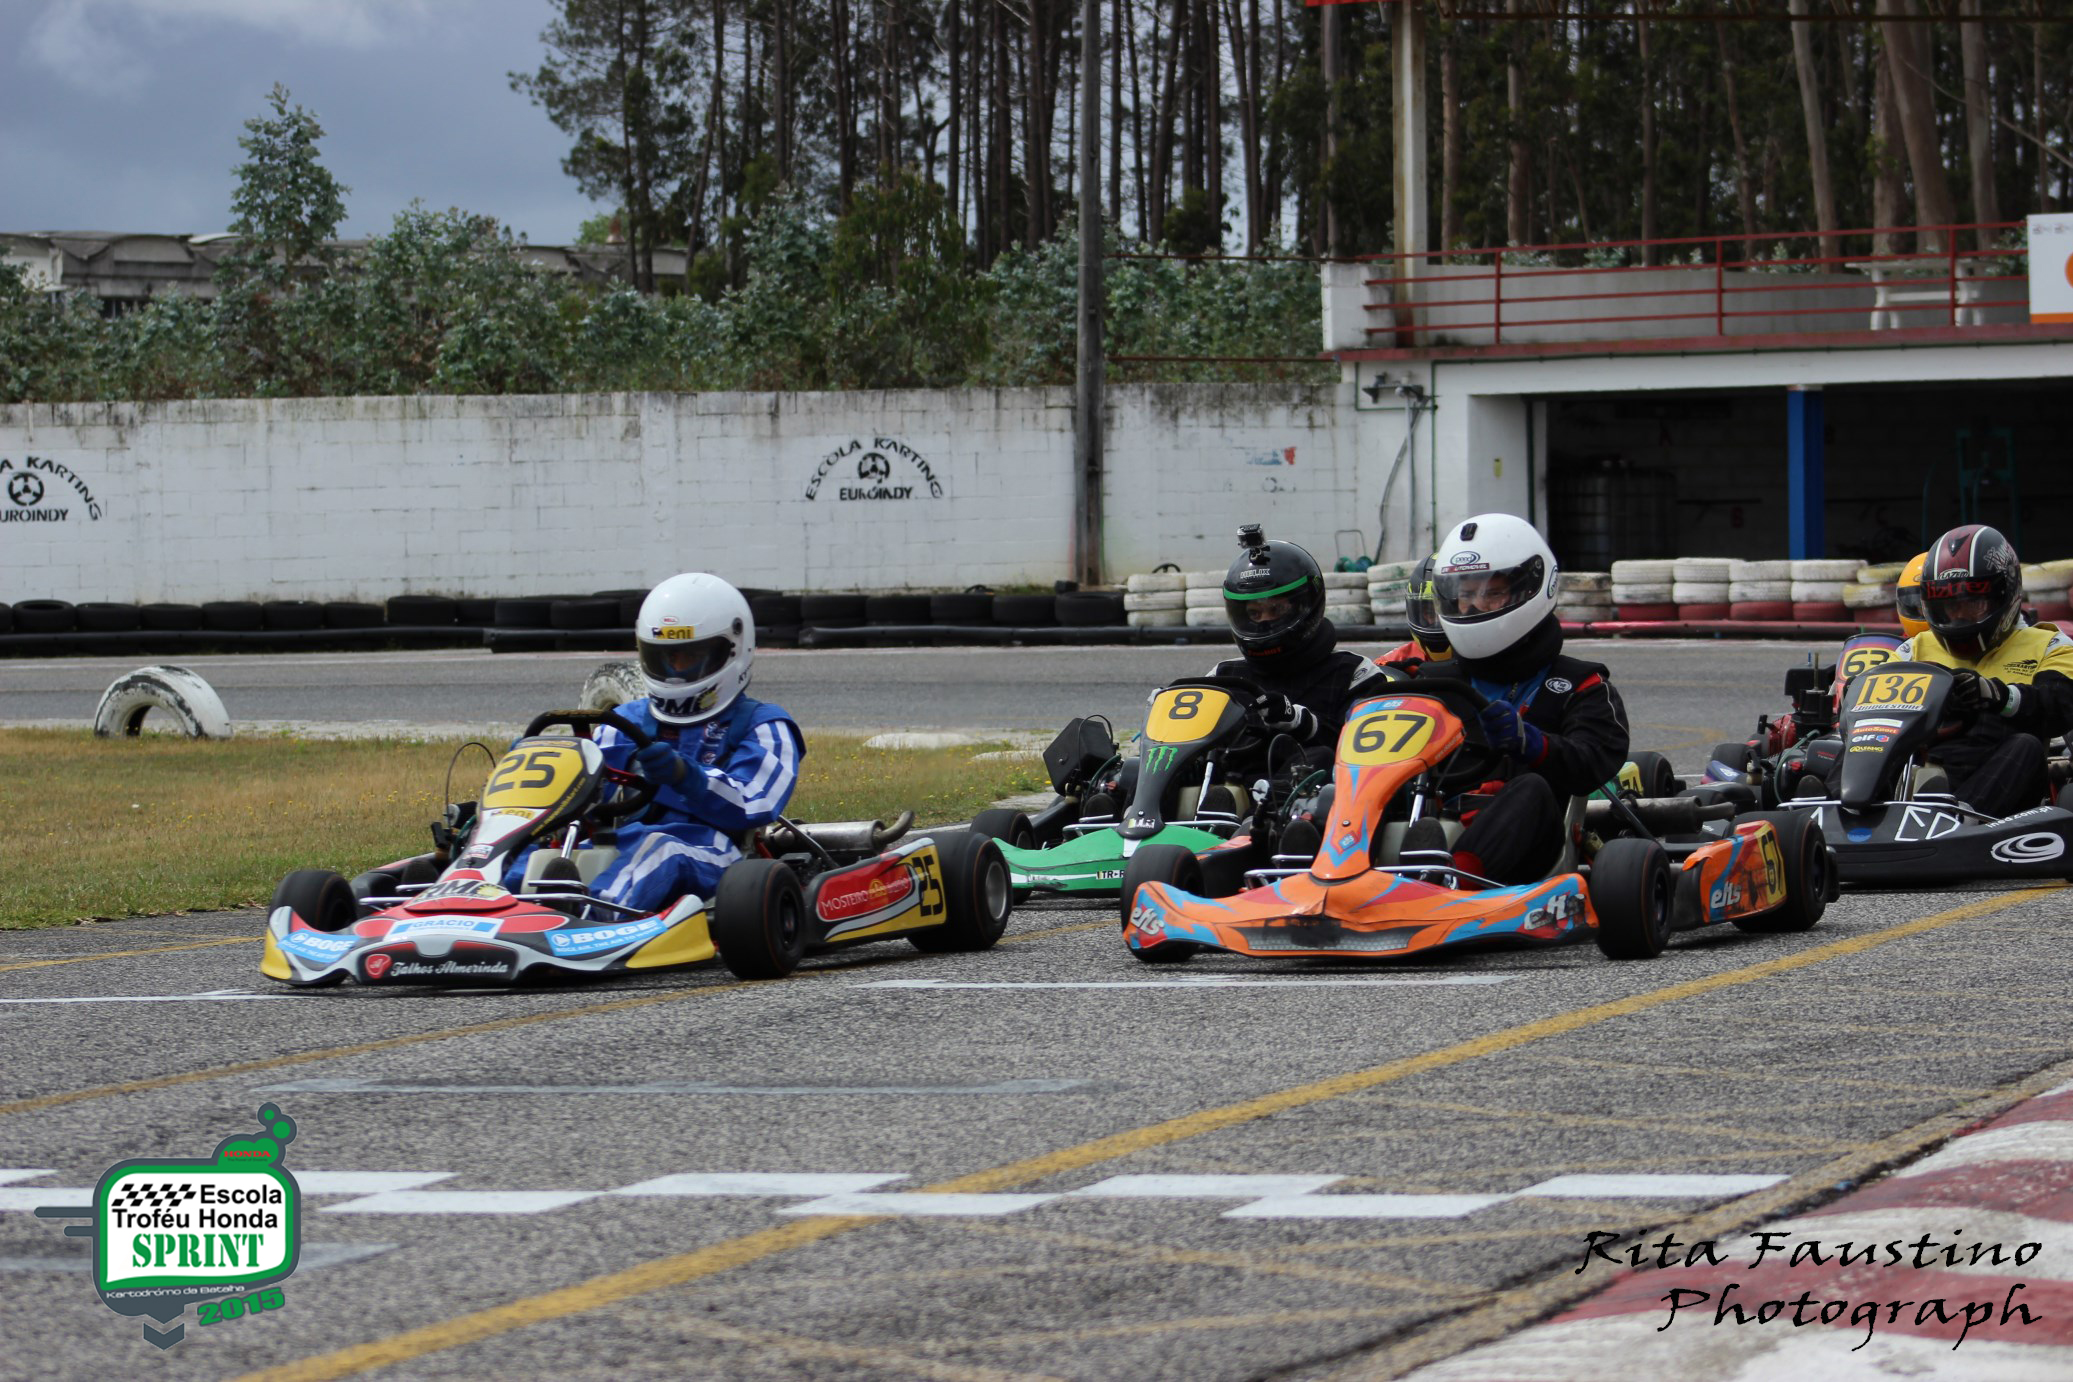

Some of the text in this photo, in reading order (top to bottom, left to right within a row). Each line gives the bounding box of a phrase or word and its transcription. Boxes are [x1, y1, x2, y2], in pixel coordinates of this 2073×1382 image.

[805, 437, 943, 500] ESCOLA KARTING
[27, 456, 102, 521] KARTING
[667, 626, 691, 638] eni
[1168, 691, 1203, 719] 8
[1858, 676, 1927, 706] 136
[1352, 714, 1428, 754] 67
[487, 751, 563, 796] 25
[911, 855, 943, 917] 25
[821, 889, 868, 916] MOSTEIRO
[412, 919, 474, 929] GRACIO
[571, 919, 658, 944] BOGE
[303, 936, 355, 952] BOGE
[391, 961, 433, 977] Talhos
[435, 960, 509, 974] Almerinda
